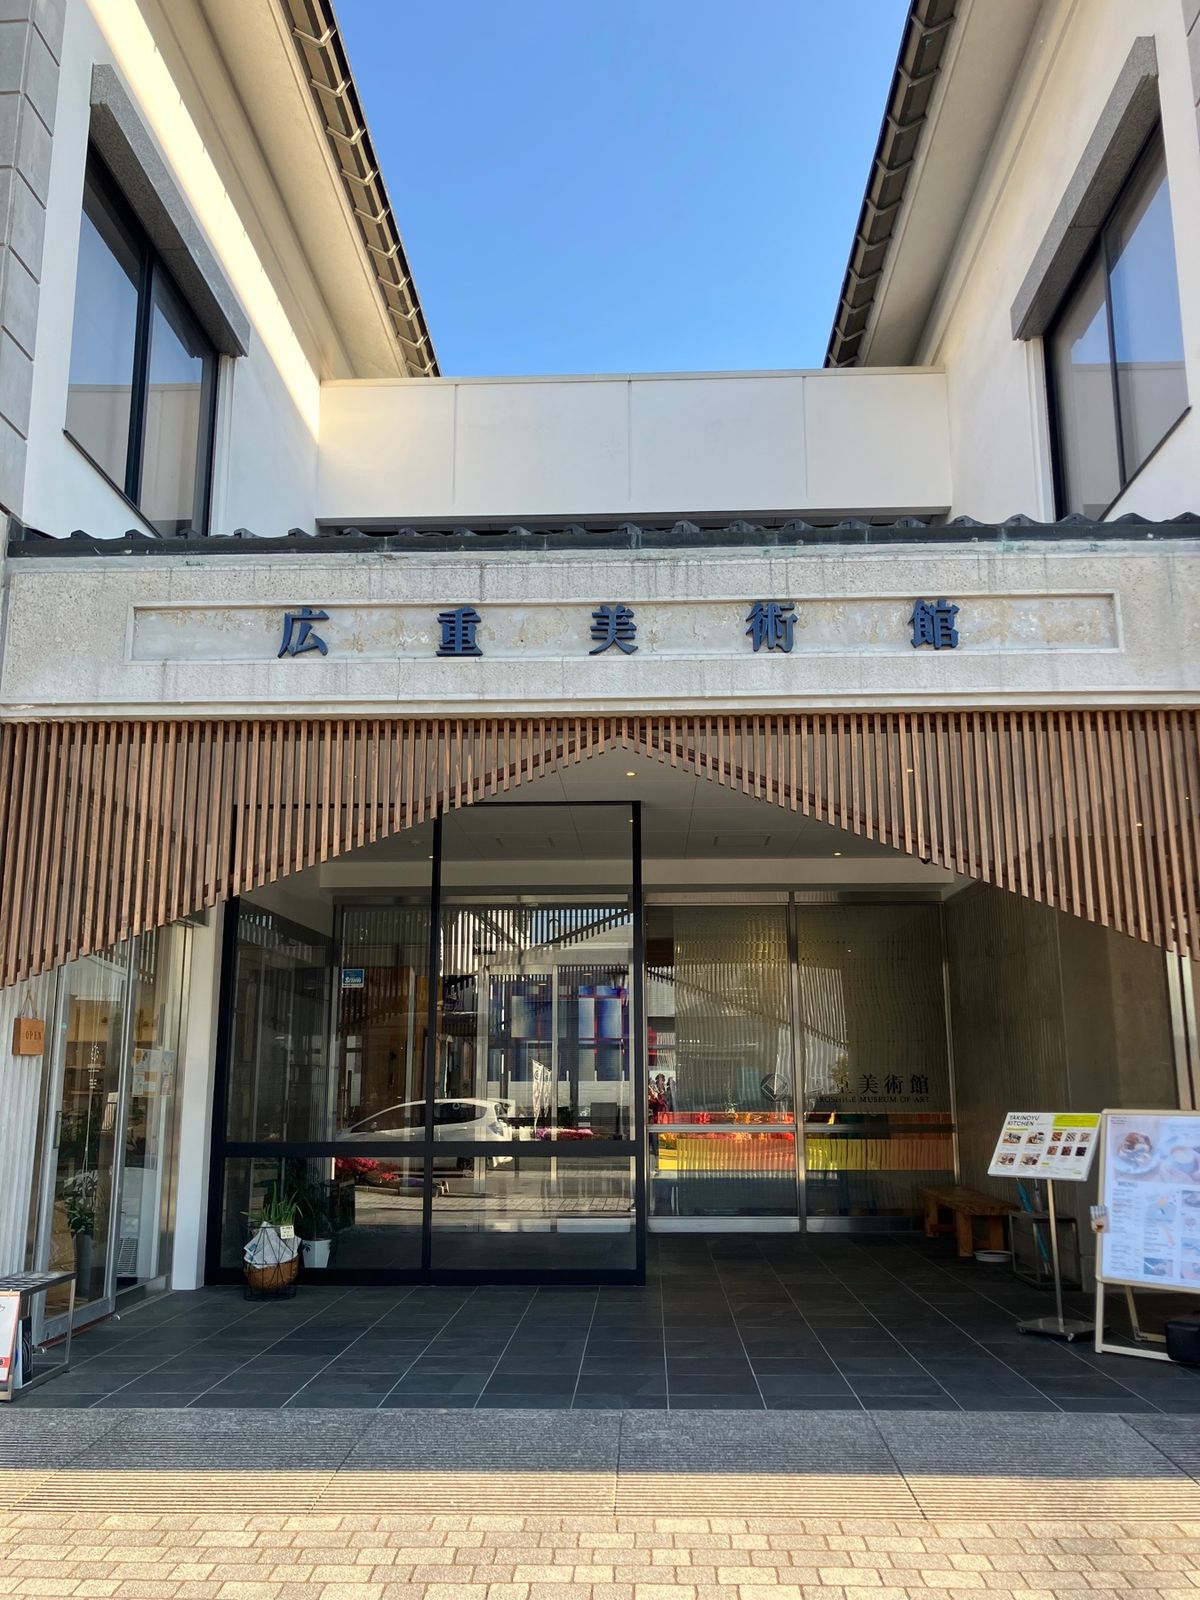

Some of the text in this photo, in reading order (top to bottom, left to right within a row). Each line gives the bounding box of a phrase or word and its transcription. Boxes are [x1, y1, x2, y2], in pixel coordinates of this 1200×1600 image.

[278, 596, 959, 658] 広重美術館
[25, 1030, 42, 1040] OPEN
